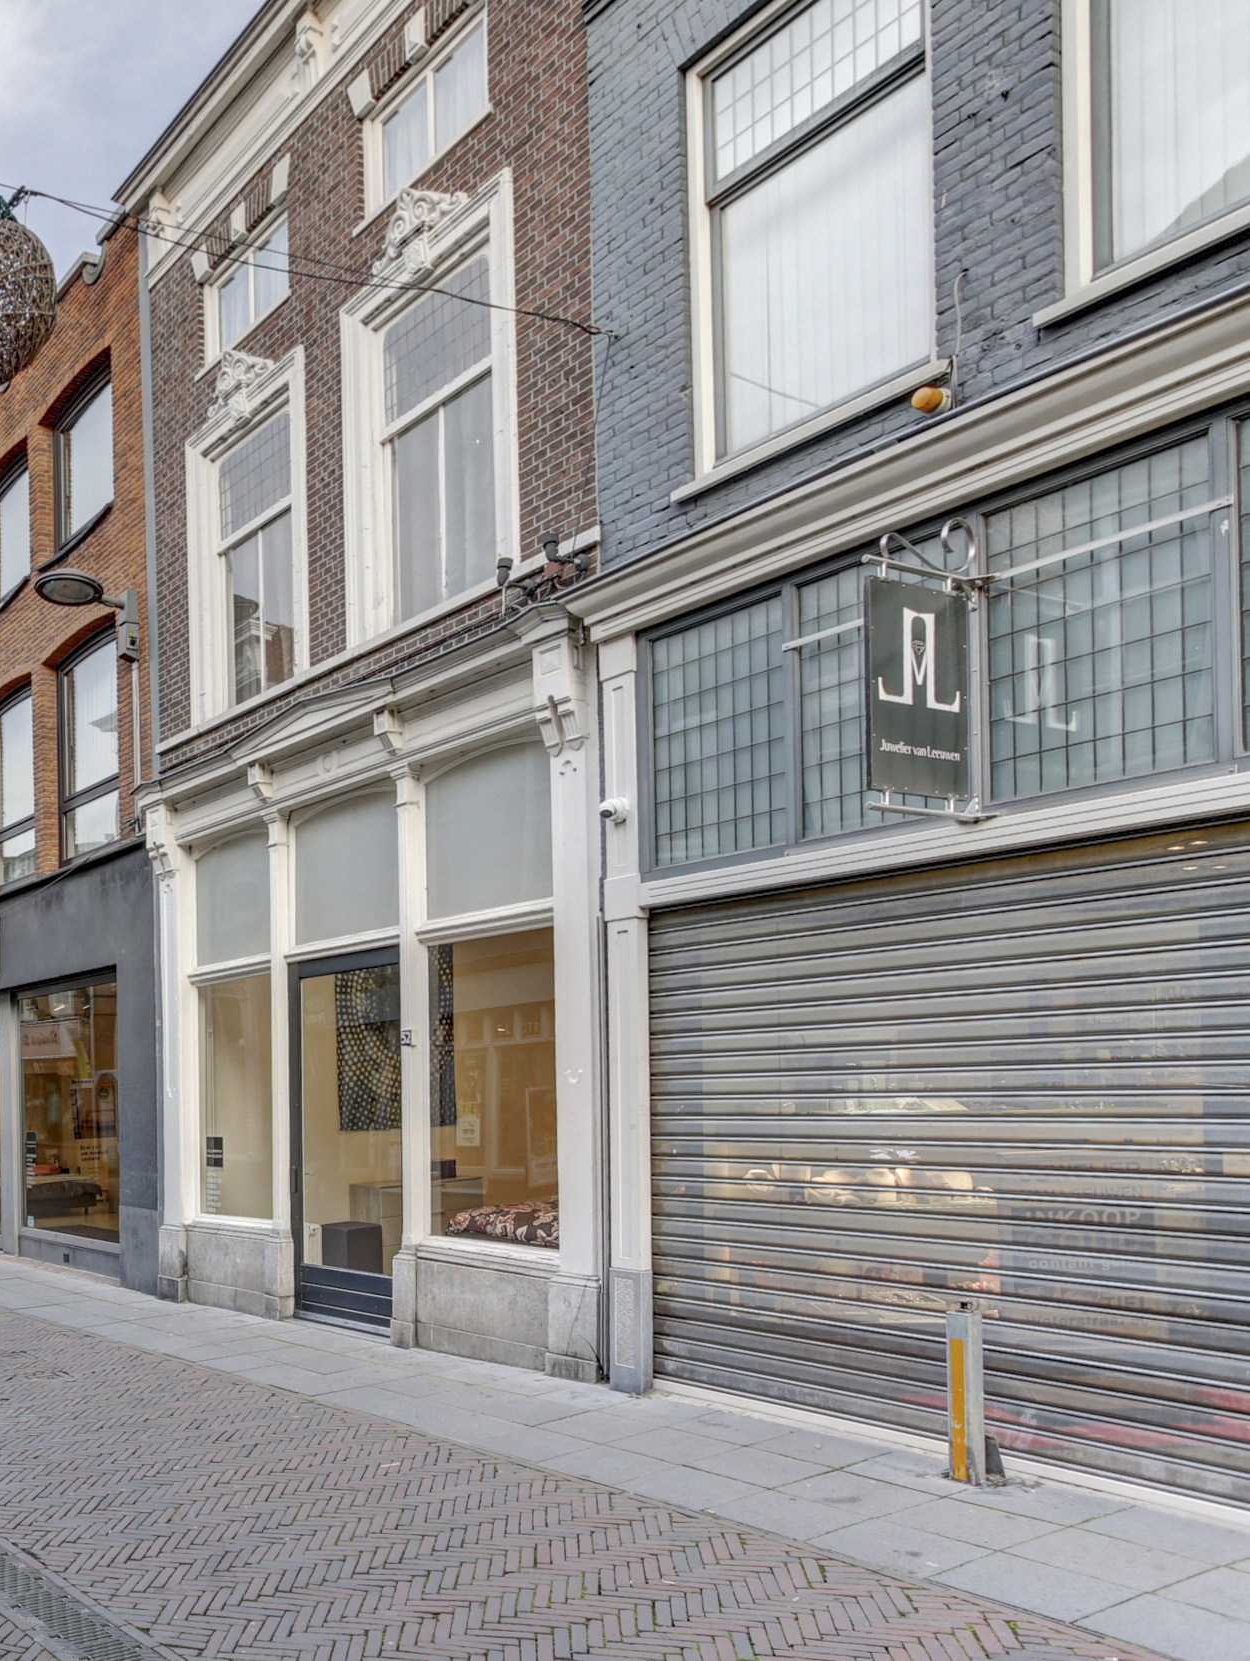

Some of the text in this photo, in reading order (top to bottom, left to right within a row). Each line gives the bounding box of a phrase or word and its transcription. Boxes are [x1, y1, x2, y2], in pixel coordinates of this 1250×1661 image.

[879, 738, 961, 762] Juwelier van Leeuwen
